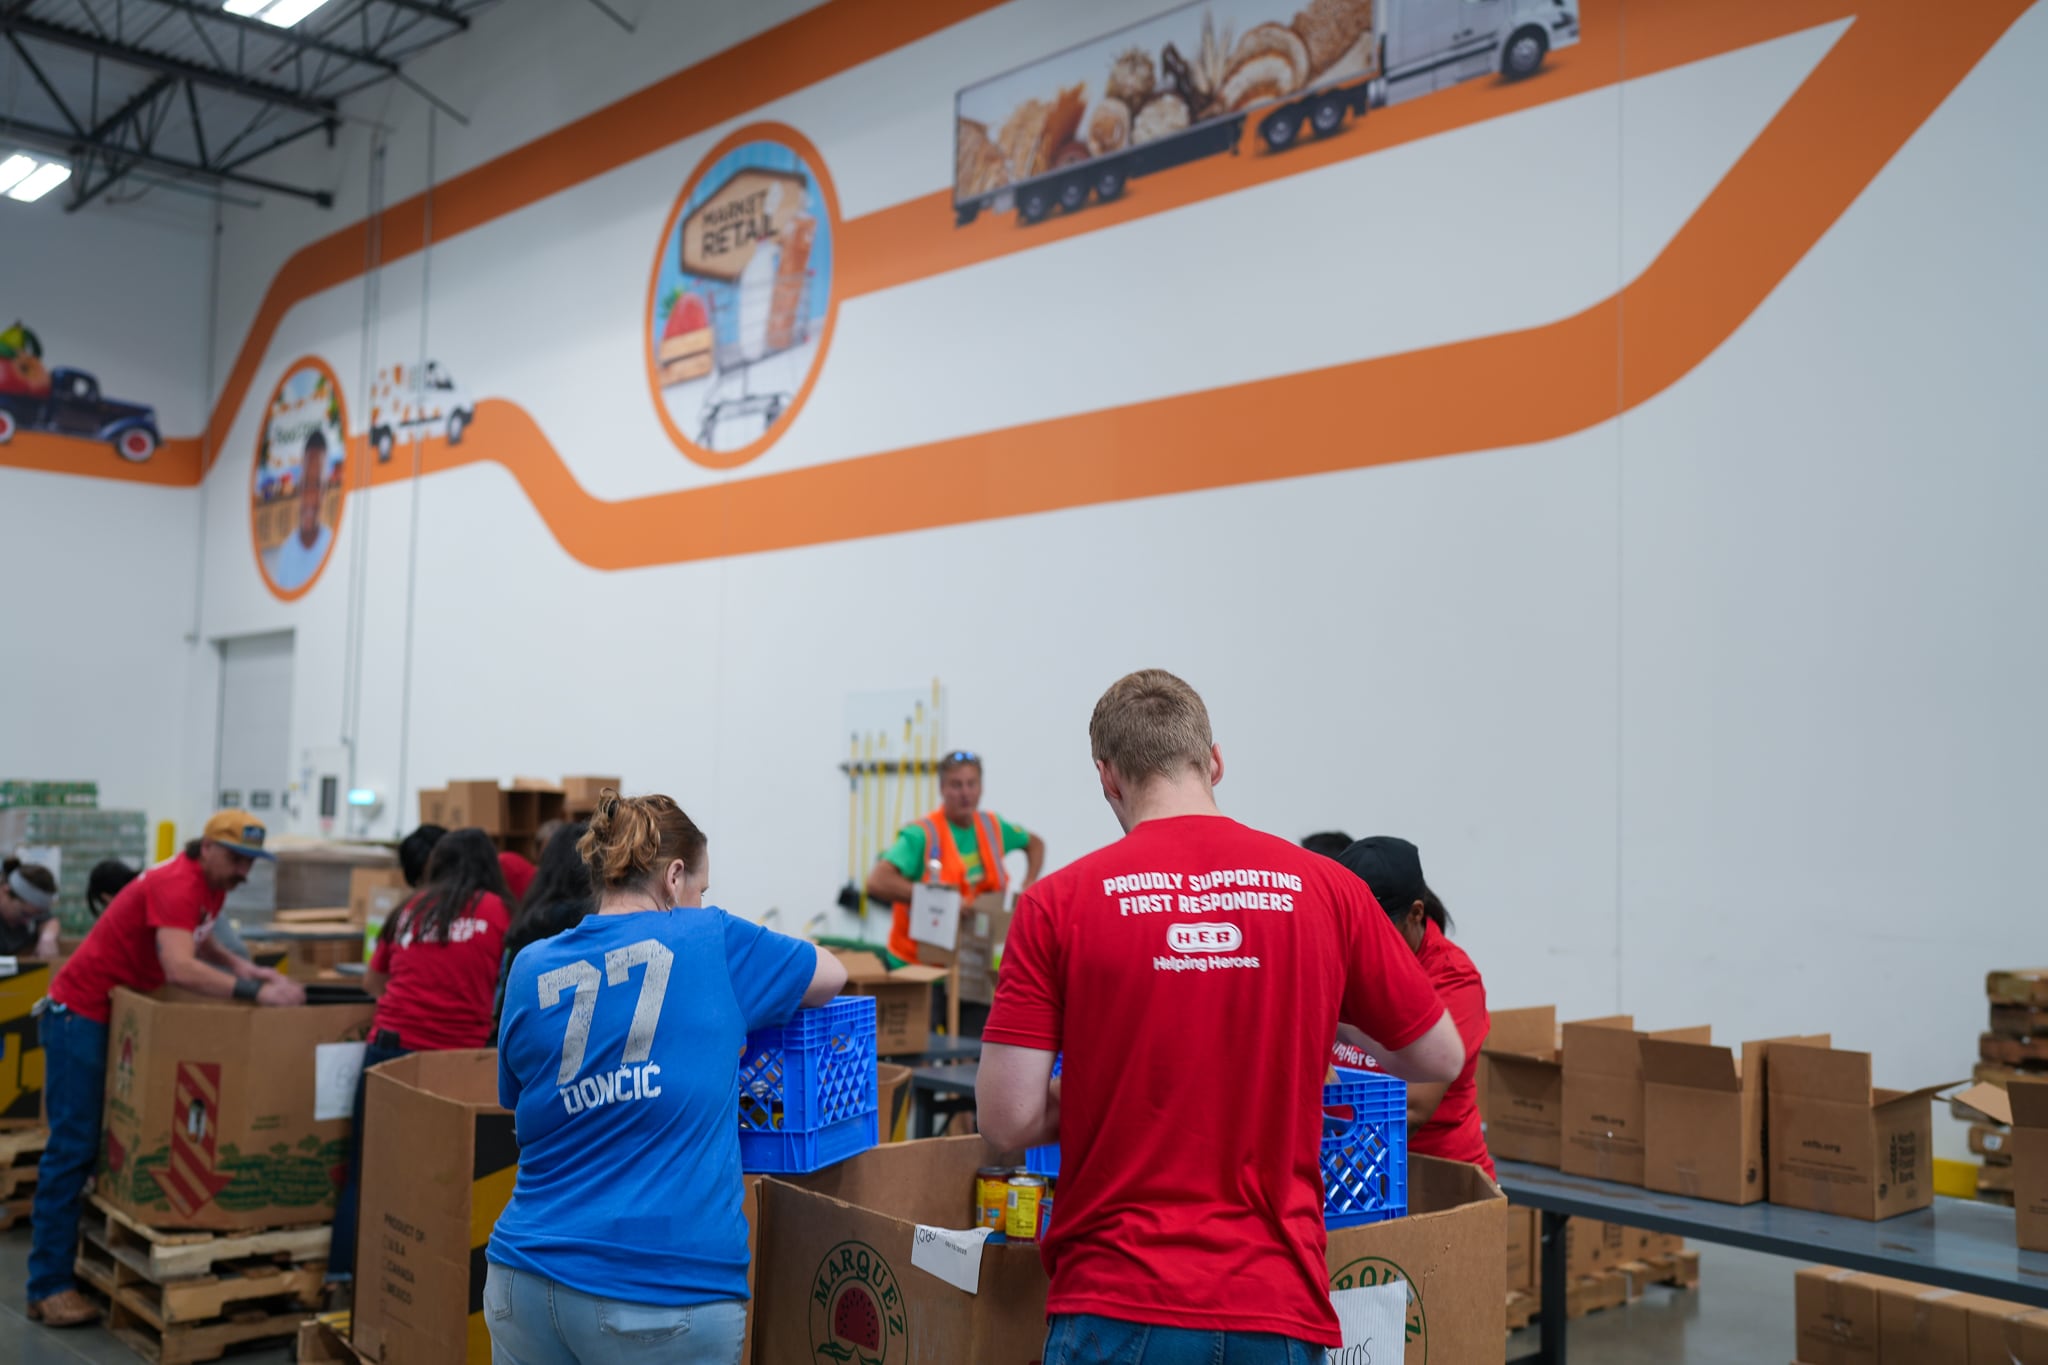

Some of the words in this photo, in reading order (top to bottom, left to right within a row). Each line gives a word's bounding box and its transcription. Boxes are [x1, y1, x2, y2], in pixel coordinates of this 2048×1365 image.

[1103, 872, 1184, 896] PROUDLY
[1188, 869, 1302, 892] SUPPORTING
[1119, 894, 1173, 916] FIRST
[1178, 891, 1294, 913] RESPONDERS
[1153, 955, 1208, 973] Helping
[1209, 955, 1261, 970] Heroes
[537, 938, 675, 1086] 77
[560, 1061, 662, 1116] DONČIĆ
[815, 1248, 904, 1337] MARQUEZ
